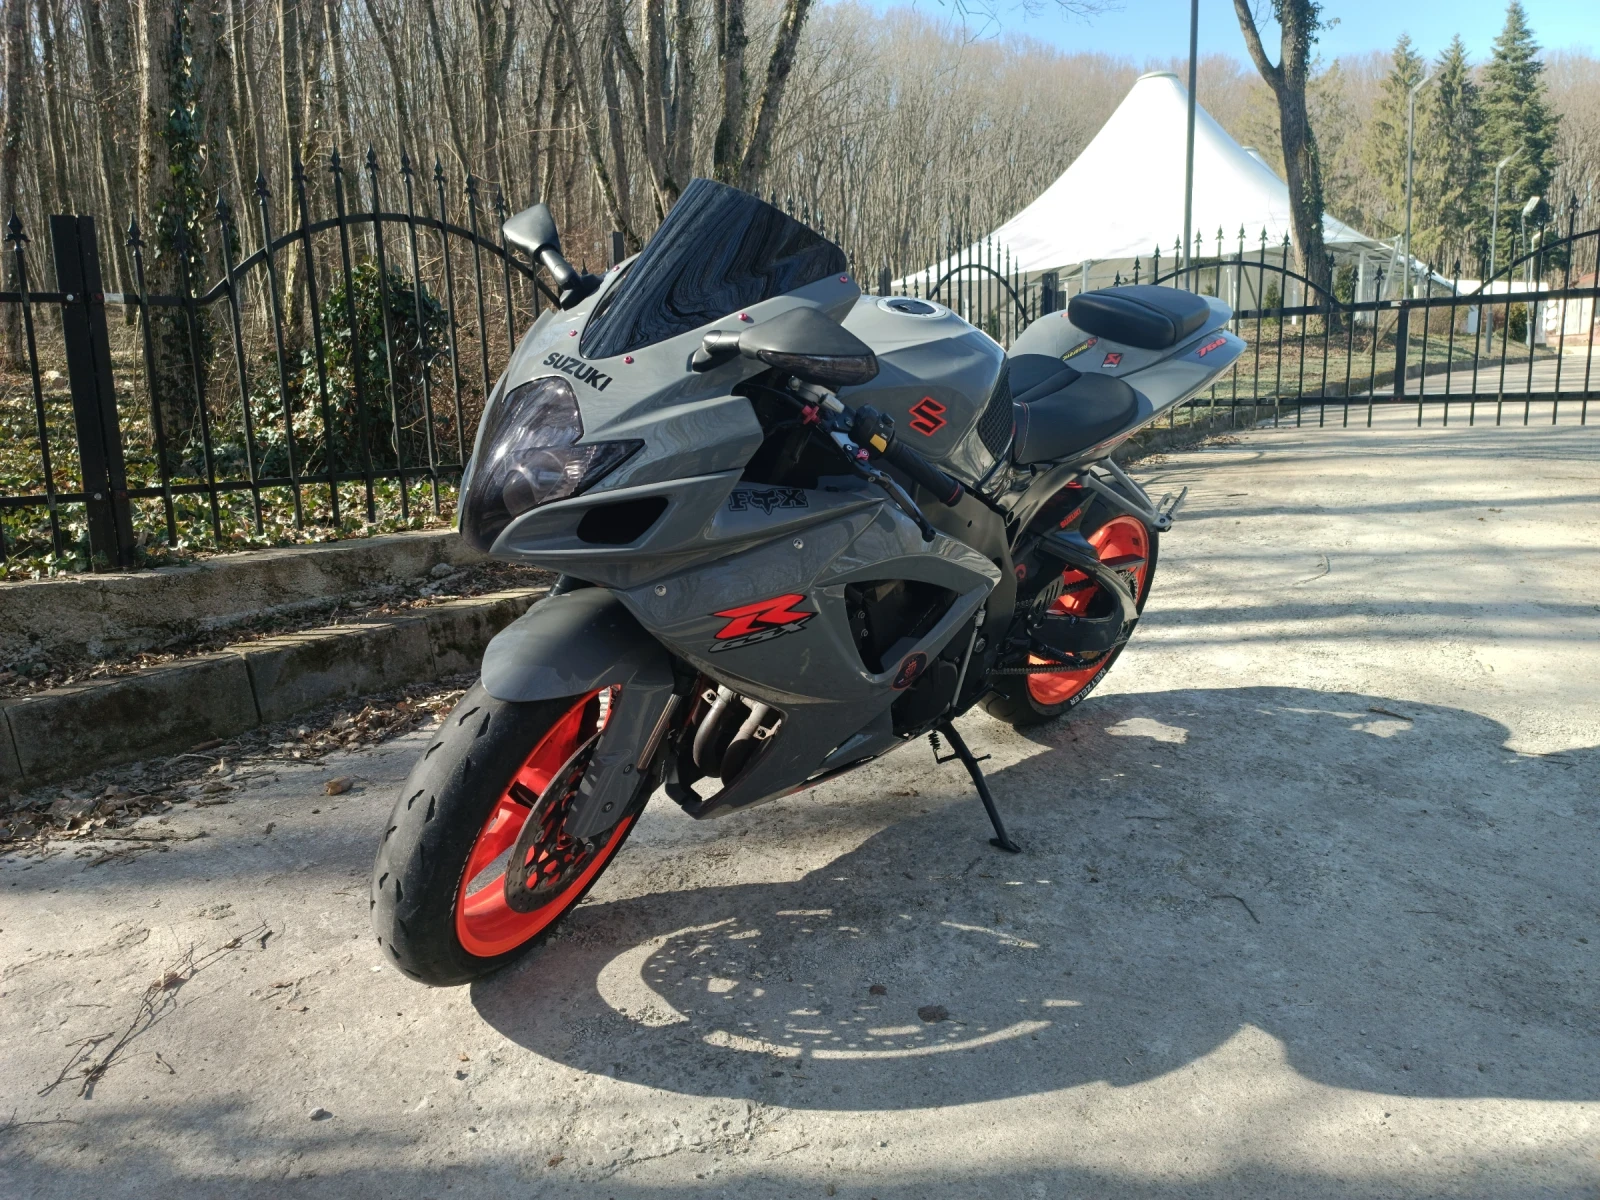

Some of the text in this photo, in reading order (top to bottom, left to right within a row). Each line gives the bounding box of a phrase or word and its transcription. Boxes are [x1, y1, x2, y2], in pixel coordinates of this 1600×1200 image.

[1195, 337, 1227, 358] 750
[543, 352, 613, 392] SUZUKI
[1070, 667, 1107, 706] METZELER
